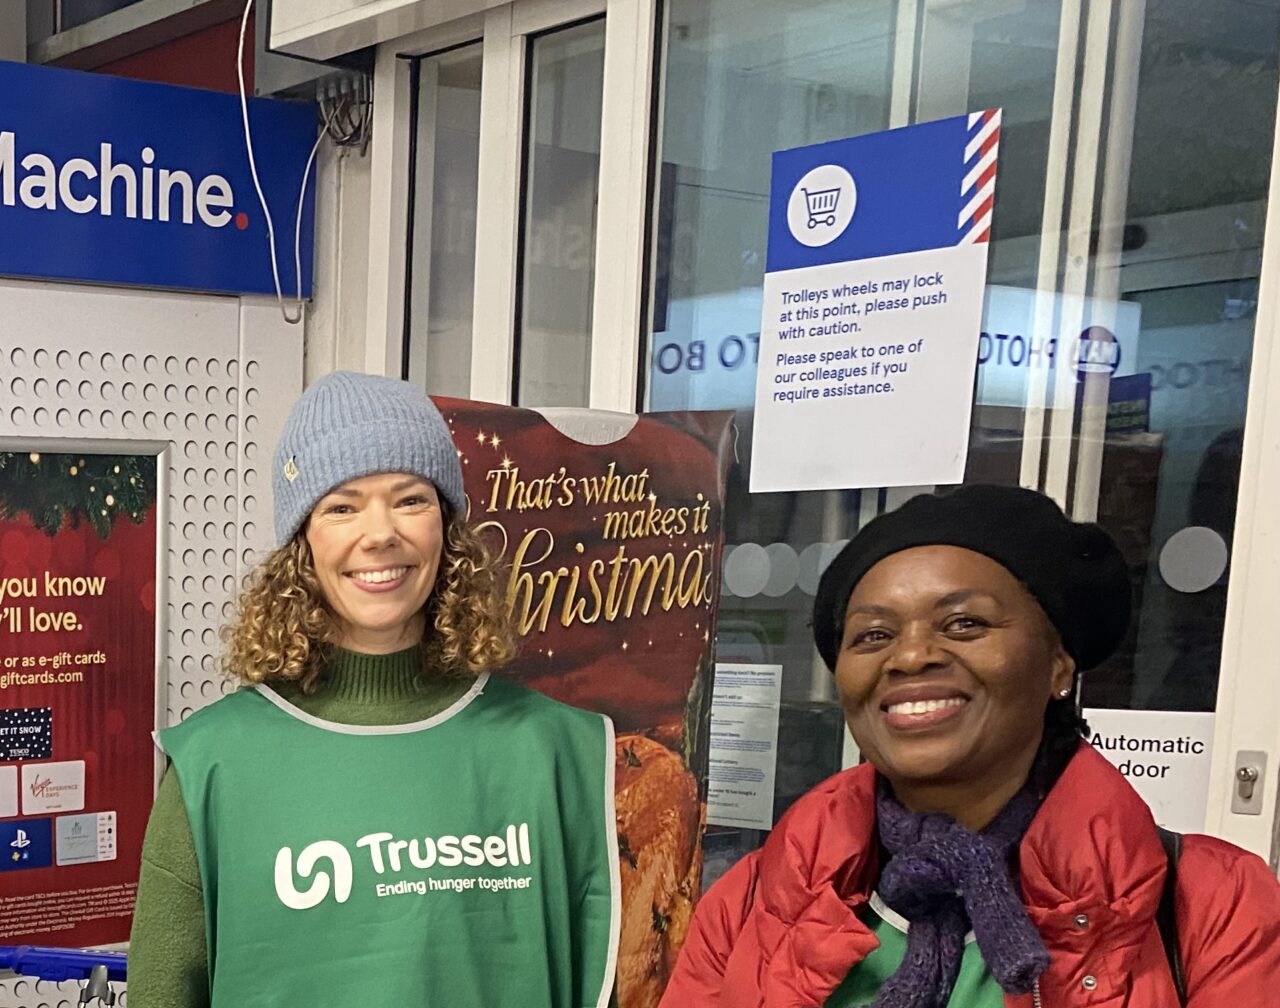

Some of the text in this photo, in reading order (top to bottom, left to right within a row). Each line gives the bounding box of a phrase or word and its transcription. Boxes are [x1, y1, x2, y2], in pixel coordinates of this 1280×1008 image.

[781, 271, 944, 305] Trolleys wheels may lock
[779, 290, 948, 323] at this point, please push
[778, 319, 862, 341] with caution.
[776, 339, 924, 367] Please speak to one of
[774, 361, 908, 384] our colleagues if you
[773, 380, 895, 403] require assistance.
[486, 461, 649, 513] That's what
[603, 492, 711, 541] makes it
[45, 571, 107, 597] know
[472, 521, 713, 636] hristma
[29, 607, 83, 633] love.
[4, 656, 19, 667] or
[22, 655, 35, 667] as
[39, 652, 72, 668] e-gift
[74, 650, 107, 665] cards
[10, 727, 18, 735] IT
[19, 725, 42, 735] SNOW
[1091, 733, 1204, 754] Automatic
[1119, 760, 1170, 778] door
[356, 822, 531, 874] Trussell
[376, 876, 532, 897] Ending hunger together
